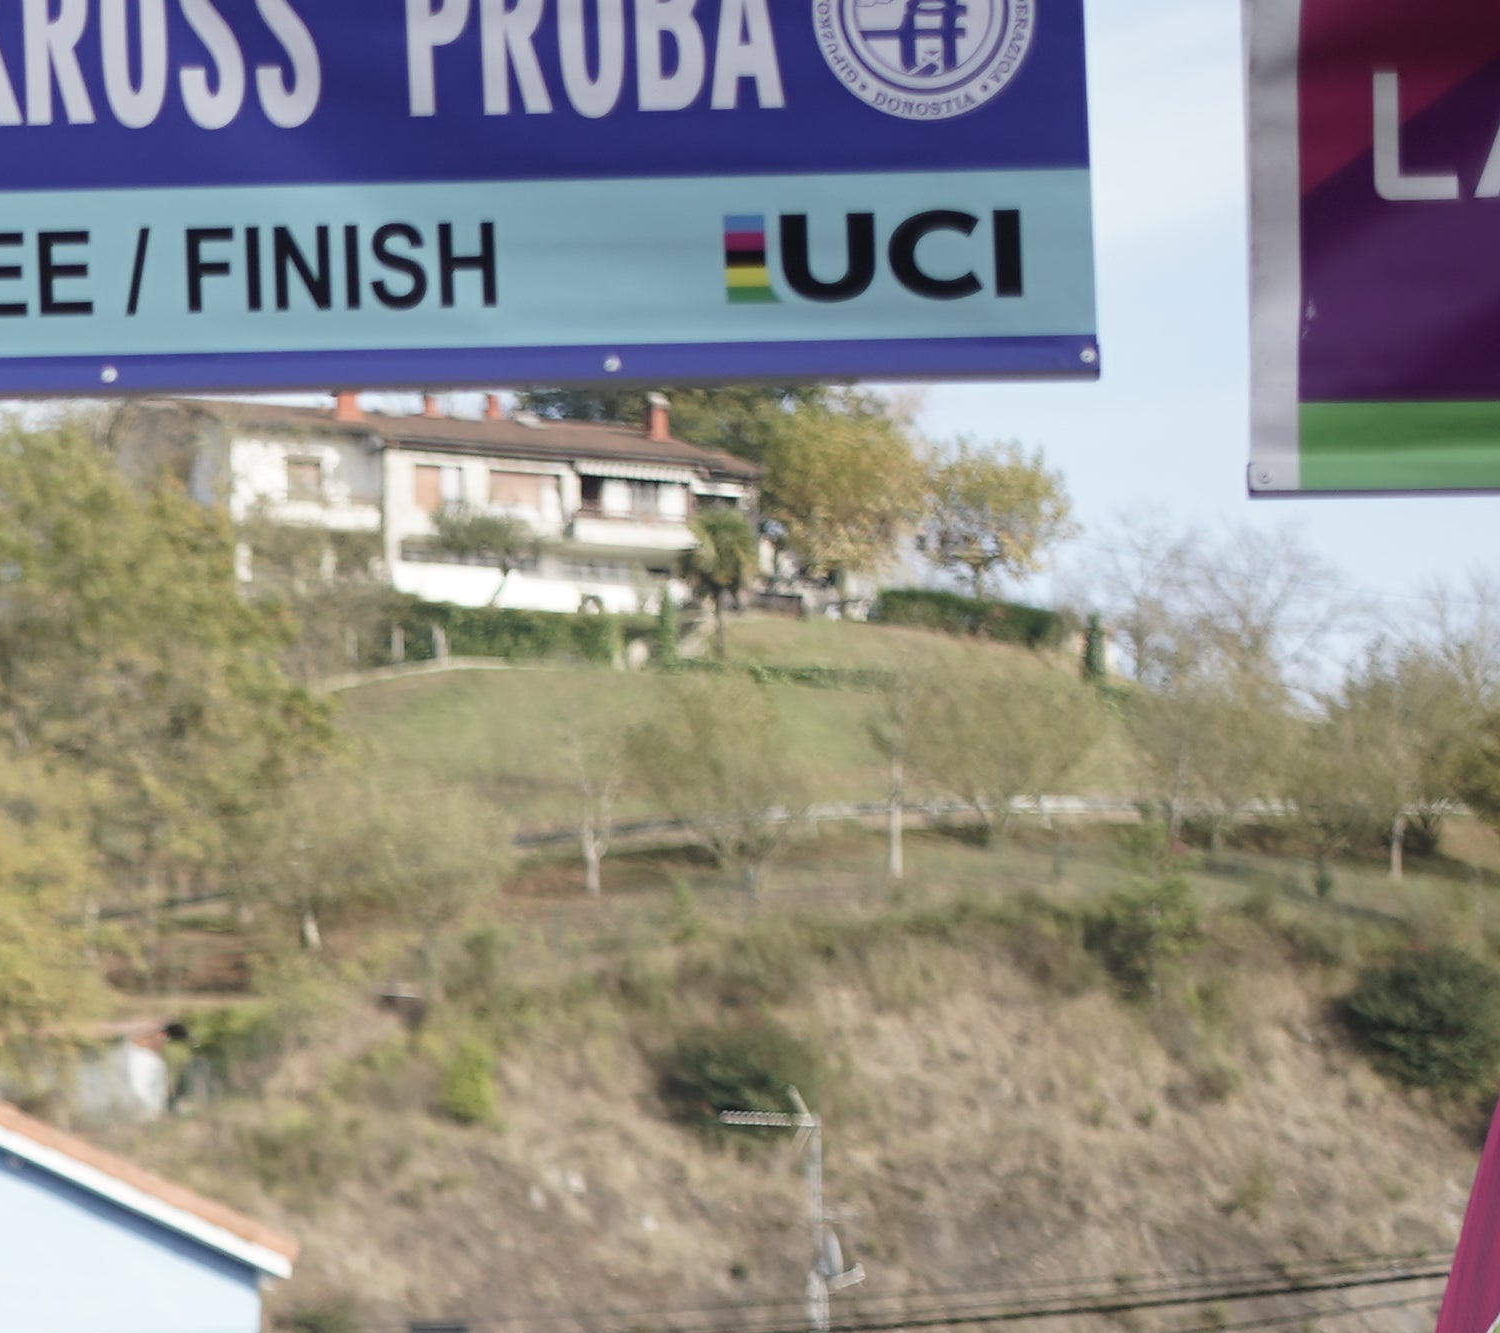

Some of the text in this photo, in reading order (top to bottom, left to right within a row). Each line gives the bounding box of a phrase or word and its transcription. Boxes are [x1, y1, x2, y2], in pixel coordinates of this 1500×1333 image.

[408, 0, 785, 118] PROBA
[874, 91, 975, 116] DONOSTIA
[126, 226, 151, 316] /
[184, 220, 499, 314] FINISH
[779, 207, 1025, 303] UCI
